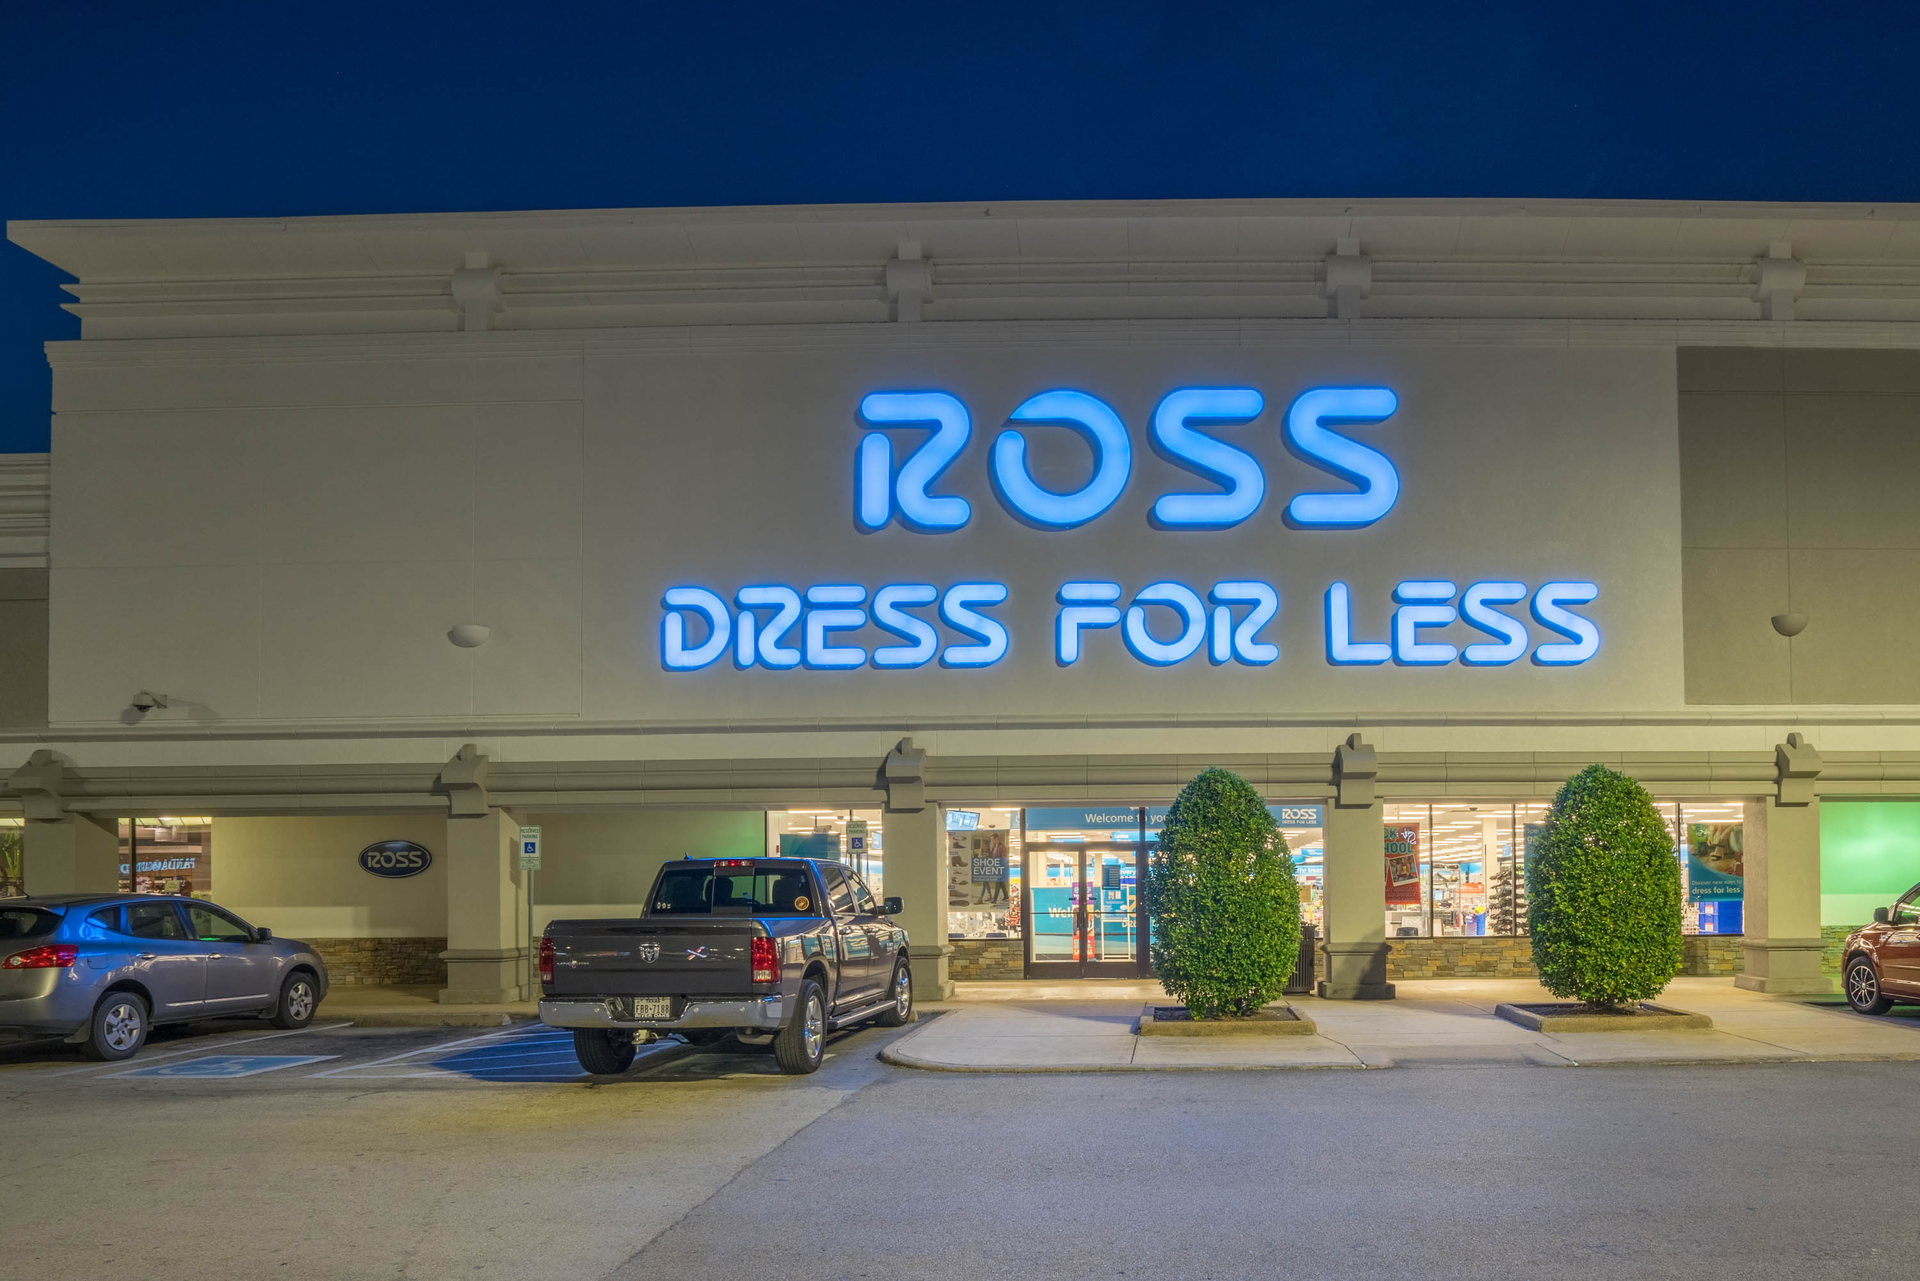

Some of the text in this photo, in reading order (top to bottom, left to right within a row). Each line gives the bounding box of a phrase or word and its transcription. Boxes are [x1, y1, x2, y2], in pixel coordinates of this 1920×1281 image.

[854, 386, 1400, 530] ROSS
[660, 579, 1602, 671] DRESS FOR LESS
[1085, 813, 1133, 823] Welcome
[1282, 808, 1317, 820] ROSS
[367, 851, 422, 868] ROSS
[973, 858, 1000, 866] SHOE
[973, 867, 1004, 875] EVENT
